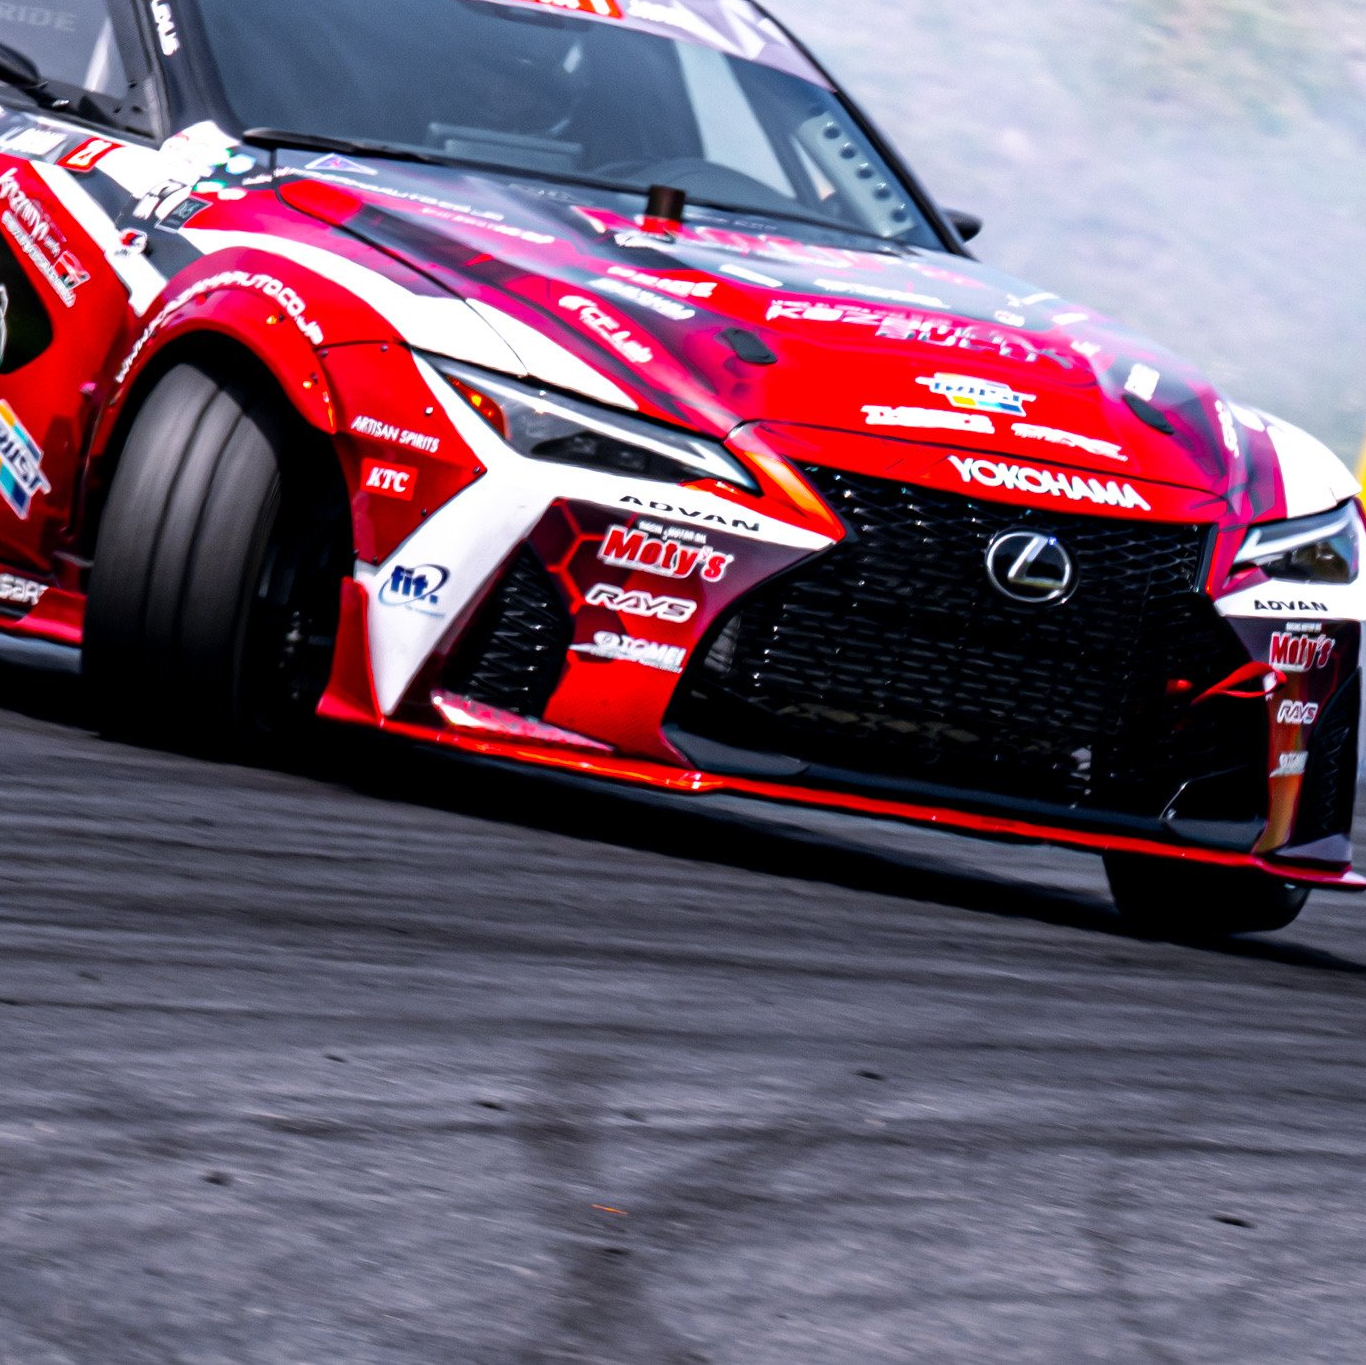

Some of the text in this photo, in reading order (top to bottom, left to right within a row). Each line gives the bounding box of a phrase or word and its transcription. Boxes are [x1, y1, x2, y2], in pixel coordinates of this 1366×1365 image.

[351, 416, 440, 453] ARTISAN SPIRITS
[365, 466, 409, 493] KTC
[947, 455, 1150, 511] YOKOHAMA
[619, 496, 761, 532] ADVAN
[599, 524, 733, 582] Moty's
[586, 584, 696, 622] RAYS
[1254, 599, 1328, 612] ADVAN
[1270, 632, 1335, 671] Moty's
[1277, 700, 1319, 724] RAYS
